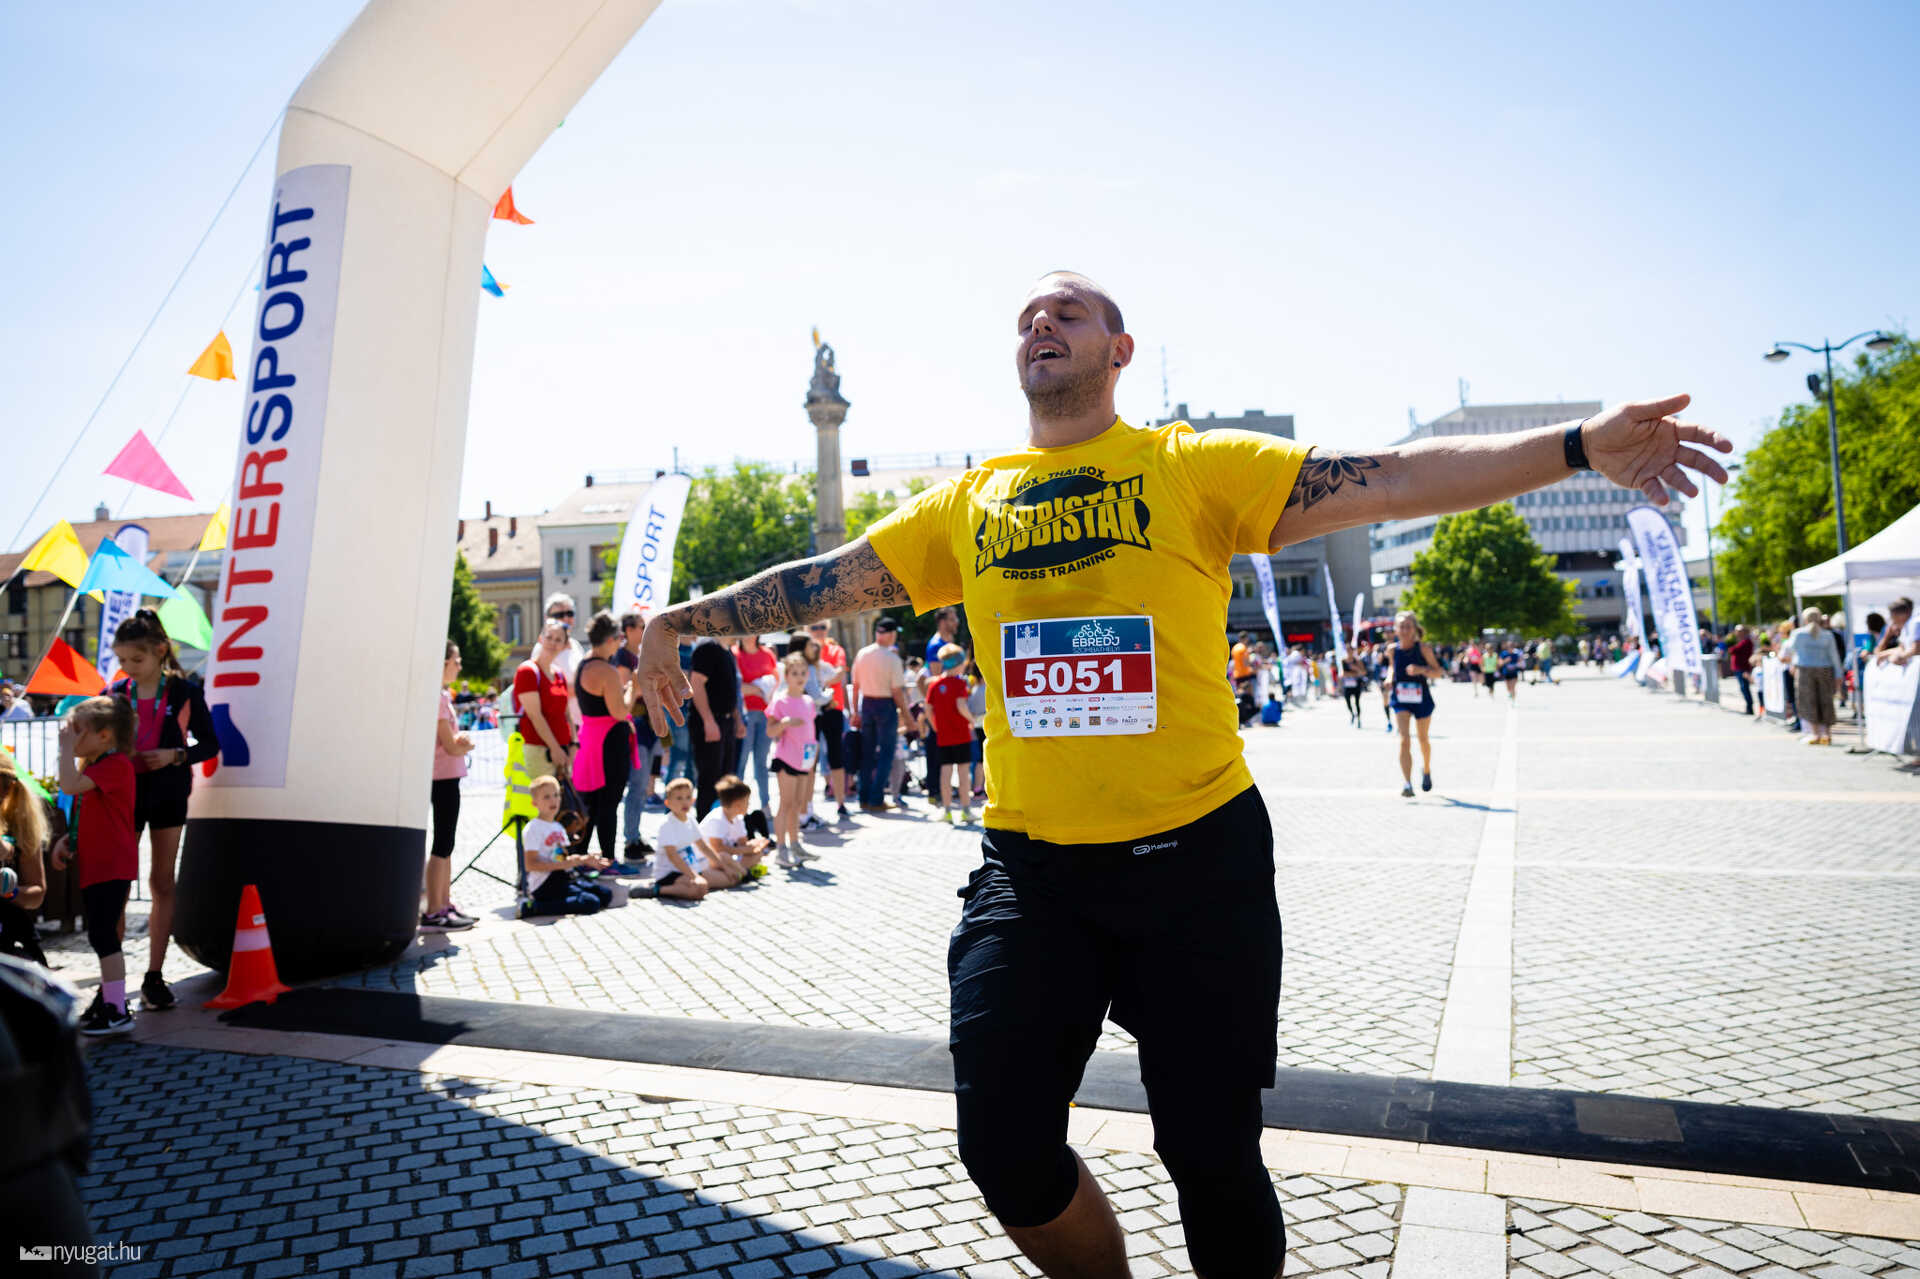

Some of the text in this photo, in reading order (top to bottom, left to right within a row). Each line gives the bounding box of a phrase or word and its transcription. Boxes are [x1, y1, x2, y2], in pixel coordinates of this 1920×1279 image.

[213, 201, 315, 689] INTERSPORT
[1016, 476, 1039, 494] BOX
[1002, 549, 1116, 580] CROSS TRAINING
[1024, 659, 1123, 694] 5051
